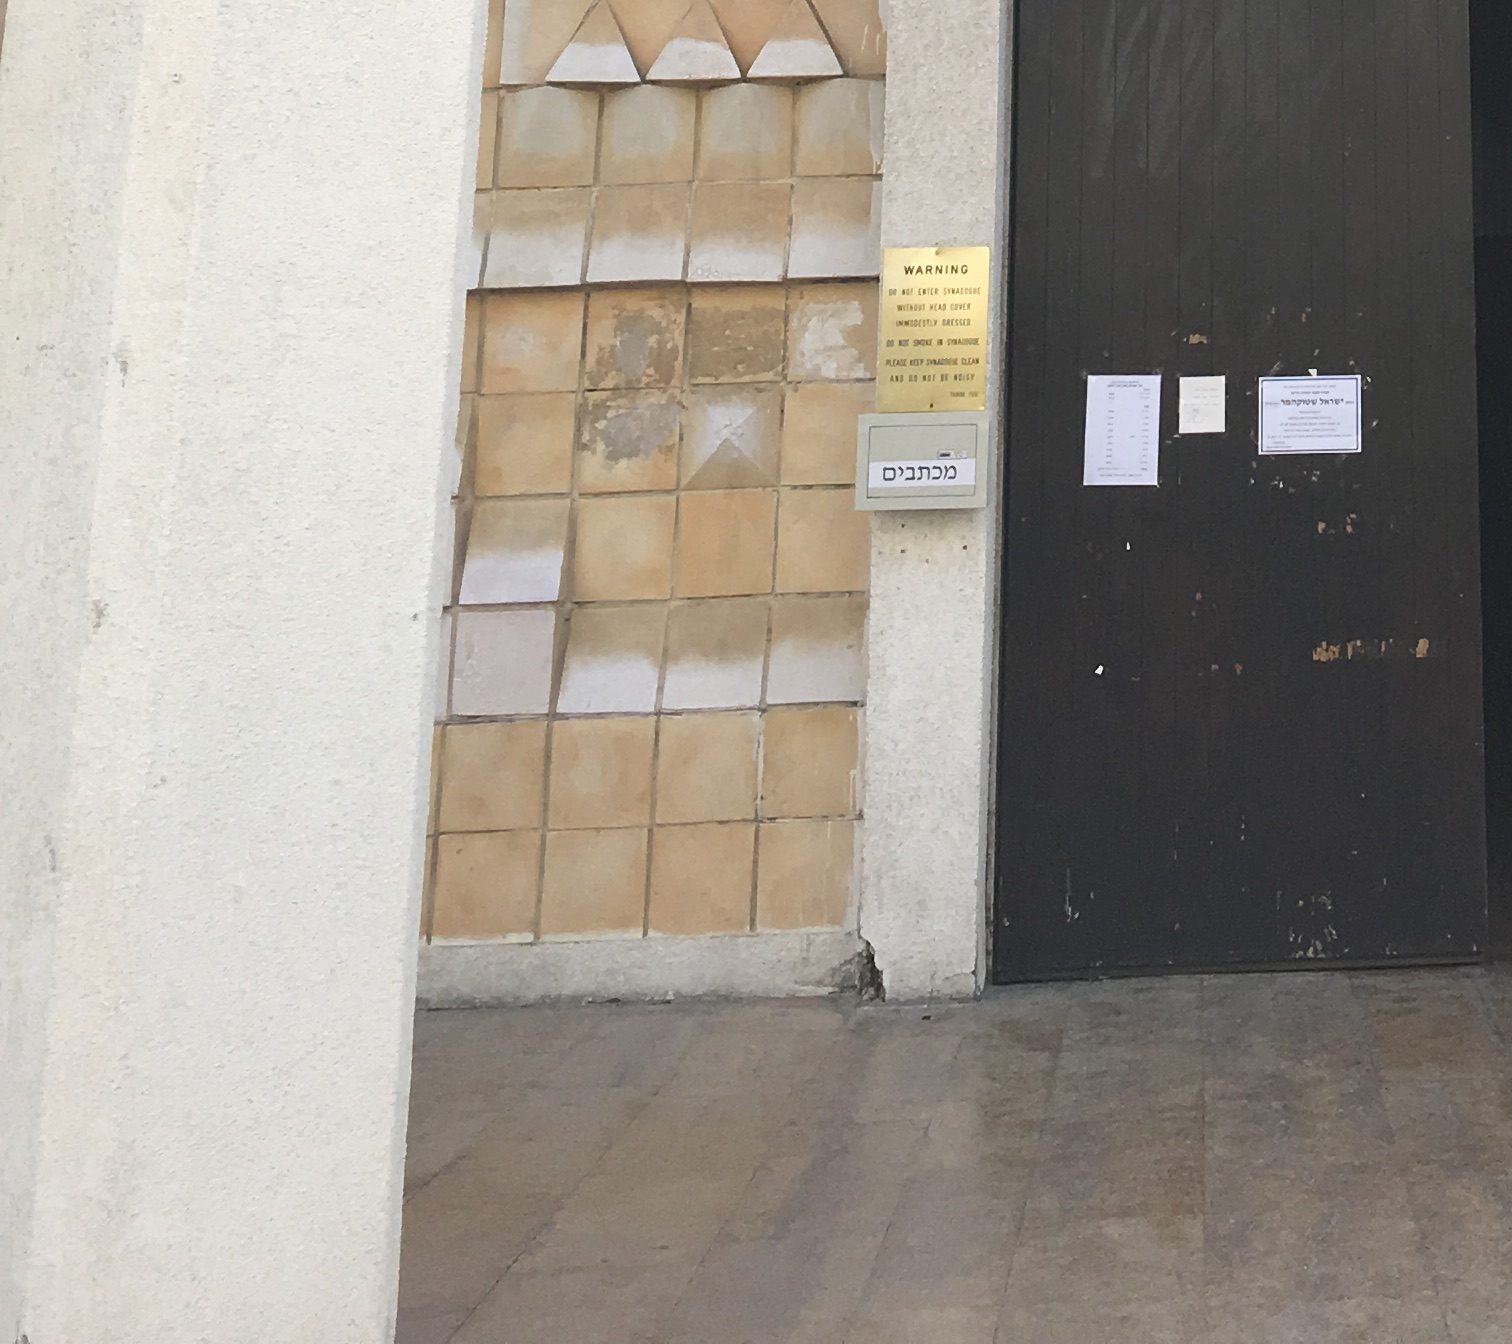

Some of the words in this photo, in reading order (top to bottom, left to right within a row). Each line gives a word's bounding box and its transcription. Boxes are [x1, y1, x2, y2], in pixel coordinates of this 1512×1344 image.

[904, 264, 968, 275] WARNING
[889, 288, 897, 296] DO
[902, 288, 913, 296] NOT
[918, 287, 939, 295] ENTER
[943, 287, 981, 295] SYNAGOGUE
[896, 303, 925, 311] WITHOUT
[930, 303, 946, 311] HEAD
[950, 302, 971, 310] COVER
[896, 318, 938, 327] IMMODESTLY
[942, 318, 971, 326] DRESSED
[886, 339, 895, 347] DO
[898, 339, 909, 347] NOT
[913, 338, 933, 347] SMOKE
[886, 358, 907, 367] PLEASE
[909, 358, 924, 366] KEEP
[961, 358, 980, 366] CLEAN
[890, 374, 904, 382] AND
[908, 374, 918, 382] DO
[922, 374, 936, 382] NOT
[940, 374, 948, 382] BE
[953, 373, 975, 381] NOISY
[1319, 397, 1344, 406] ישראל
[882, 465, 957, 481] מכתבים
